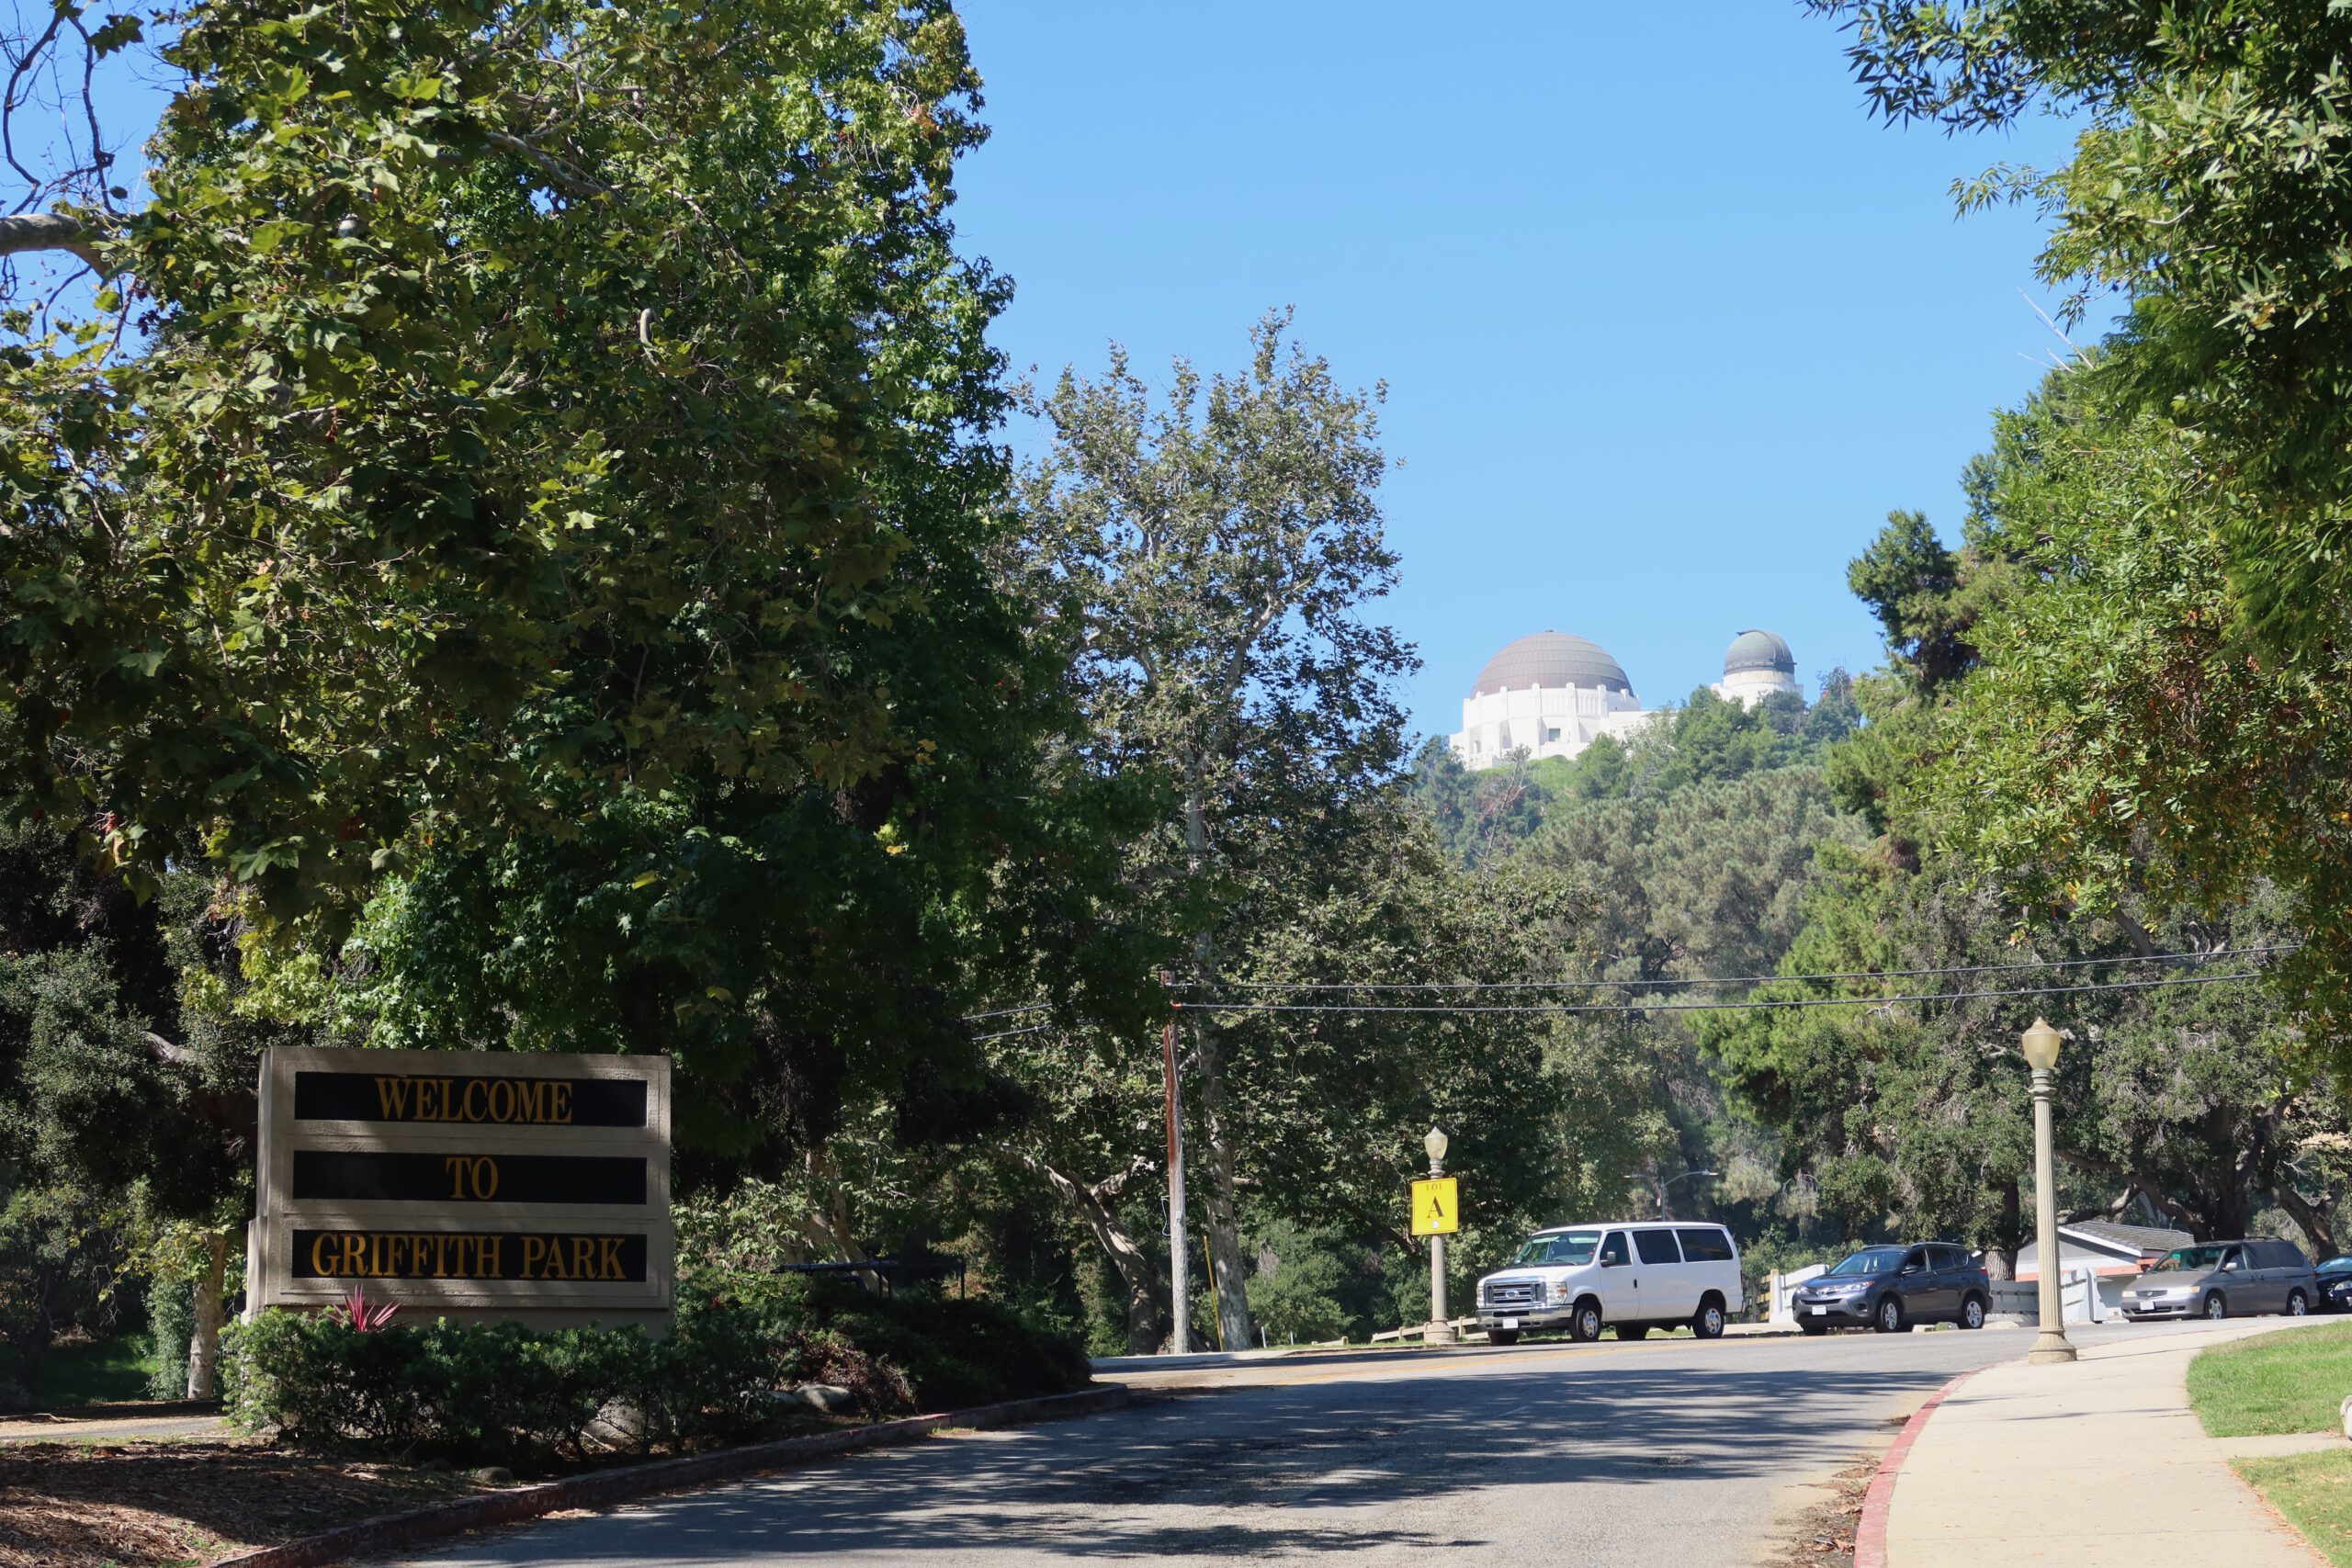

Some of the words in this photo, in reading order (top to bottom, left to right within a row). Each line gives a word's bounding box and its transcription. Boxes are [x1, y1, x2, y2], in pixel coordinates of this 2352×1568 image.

[376, 1077, 572, 1124] WELCOME
[446, 1156, 499, 1201] TO
[1427, 1196, 1444, 1218] A
[311, 1233, 503, 1279] GRIFFITH
[521, 1236, 627, 1280] PARK
